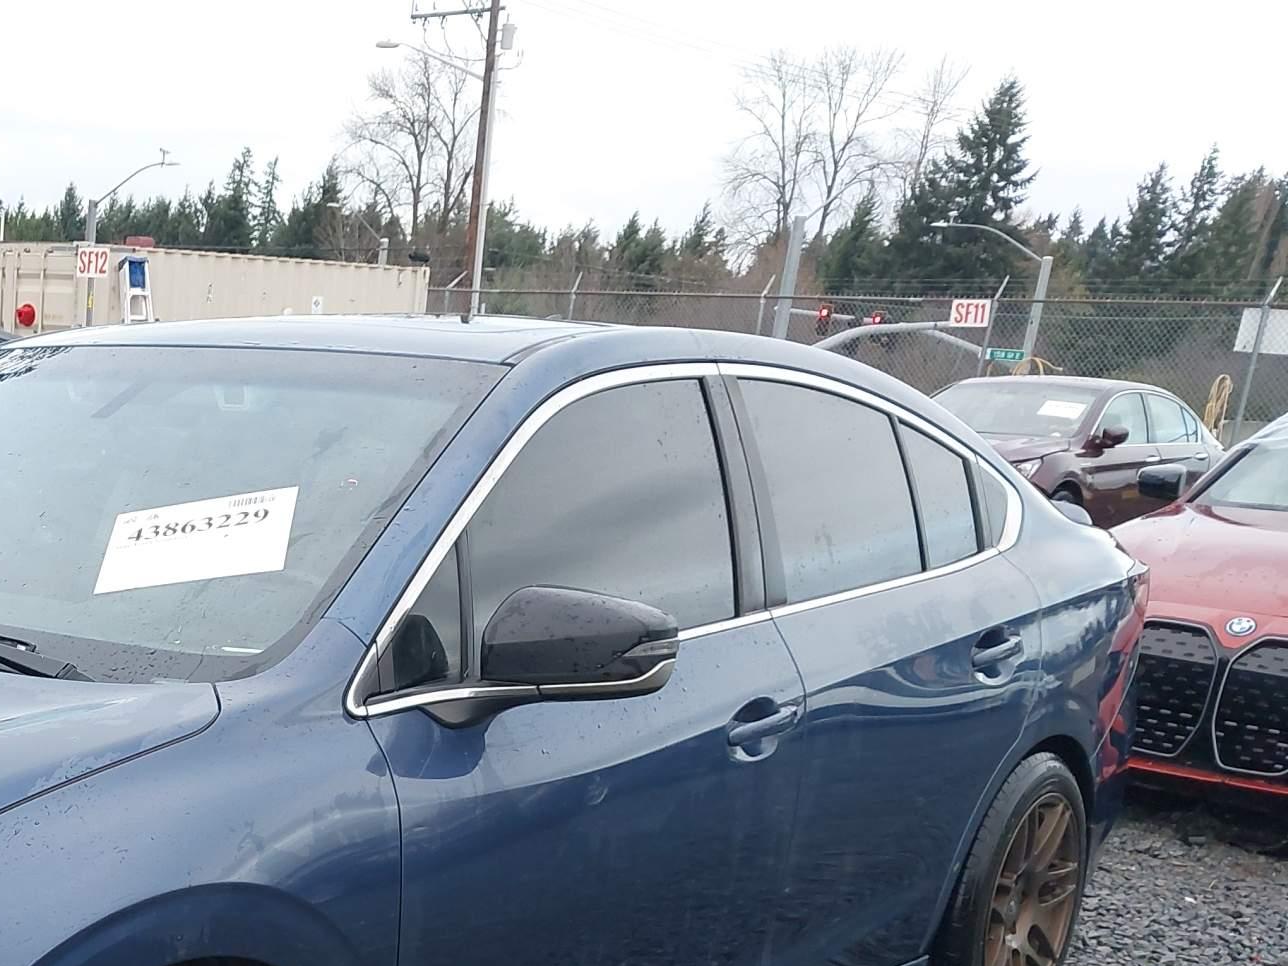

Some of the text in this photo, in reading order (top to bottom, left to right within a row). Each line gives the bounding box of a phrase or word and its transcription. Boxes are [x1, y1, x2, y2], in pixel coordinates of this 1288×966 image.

[78, 250, 108, 274] SF12
[954, 302, 987, 324] SF11
[127, 508, 270, 542] 43863229
